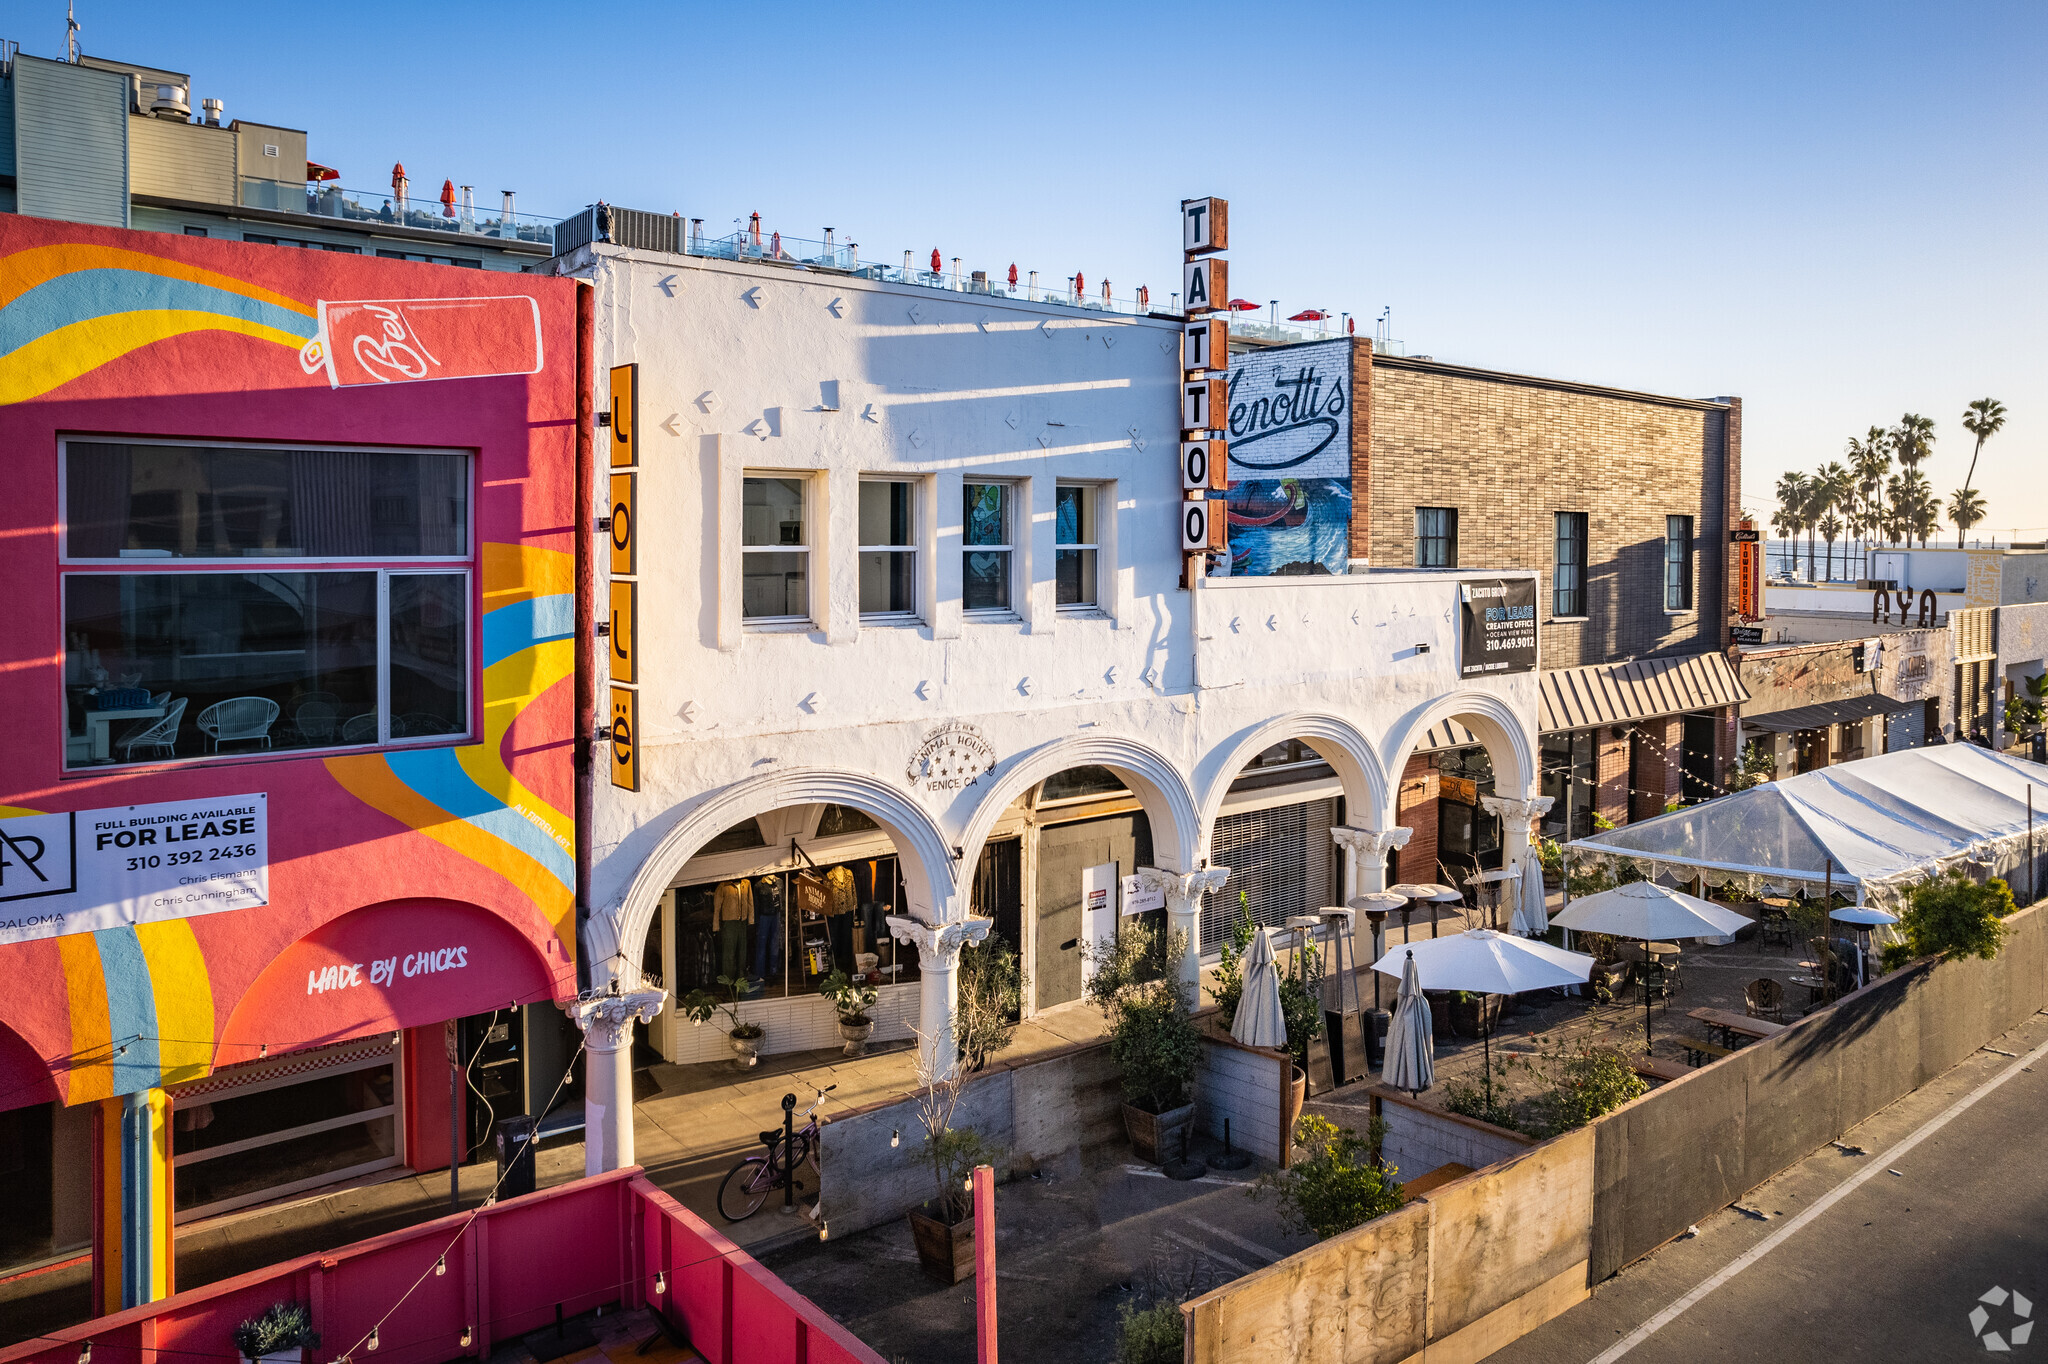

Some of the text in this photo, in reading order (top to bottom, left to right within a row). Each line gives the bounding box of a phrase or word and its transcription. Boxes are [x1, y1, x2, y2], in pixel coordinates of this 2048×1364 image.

[1186, 205, 1207, 543] TATTOO
[1485, 605, 1534, 621] FOR LEASE
[1873, 585, 1937, 627] AYA
[1485, 619, 1534, 630] CREATIVE OFFICE
[1486, 636, 1534, 651] 310.469.9012
[917, 735, 988, 766] ANIMAL HOUSE
[964, 776, 978, 787] CA
[95, 806, 256, 831] FULL BUILDING AVAILABLE
[96, 817, 255, 851] FOR LEASE
[554, 834, 571, 848] ART
[126, 843, 256, 871] 310 392 2436
[179, 869, 257, 885] Chris Eismann
[154, 895, 183, 907] Chris
[186, 886, 257, 903] Cunningham
[805, 886, 826, 903] ANIMAL
[0, 912, 65, 930] PALOMA
[27, 922, 66, 932] PARTNERS
[307, 946, 468, 995] MADE BY CHICKS
[293, 1034, 380, 1056] CALIFORNIA
